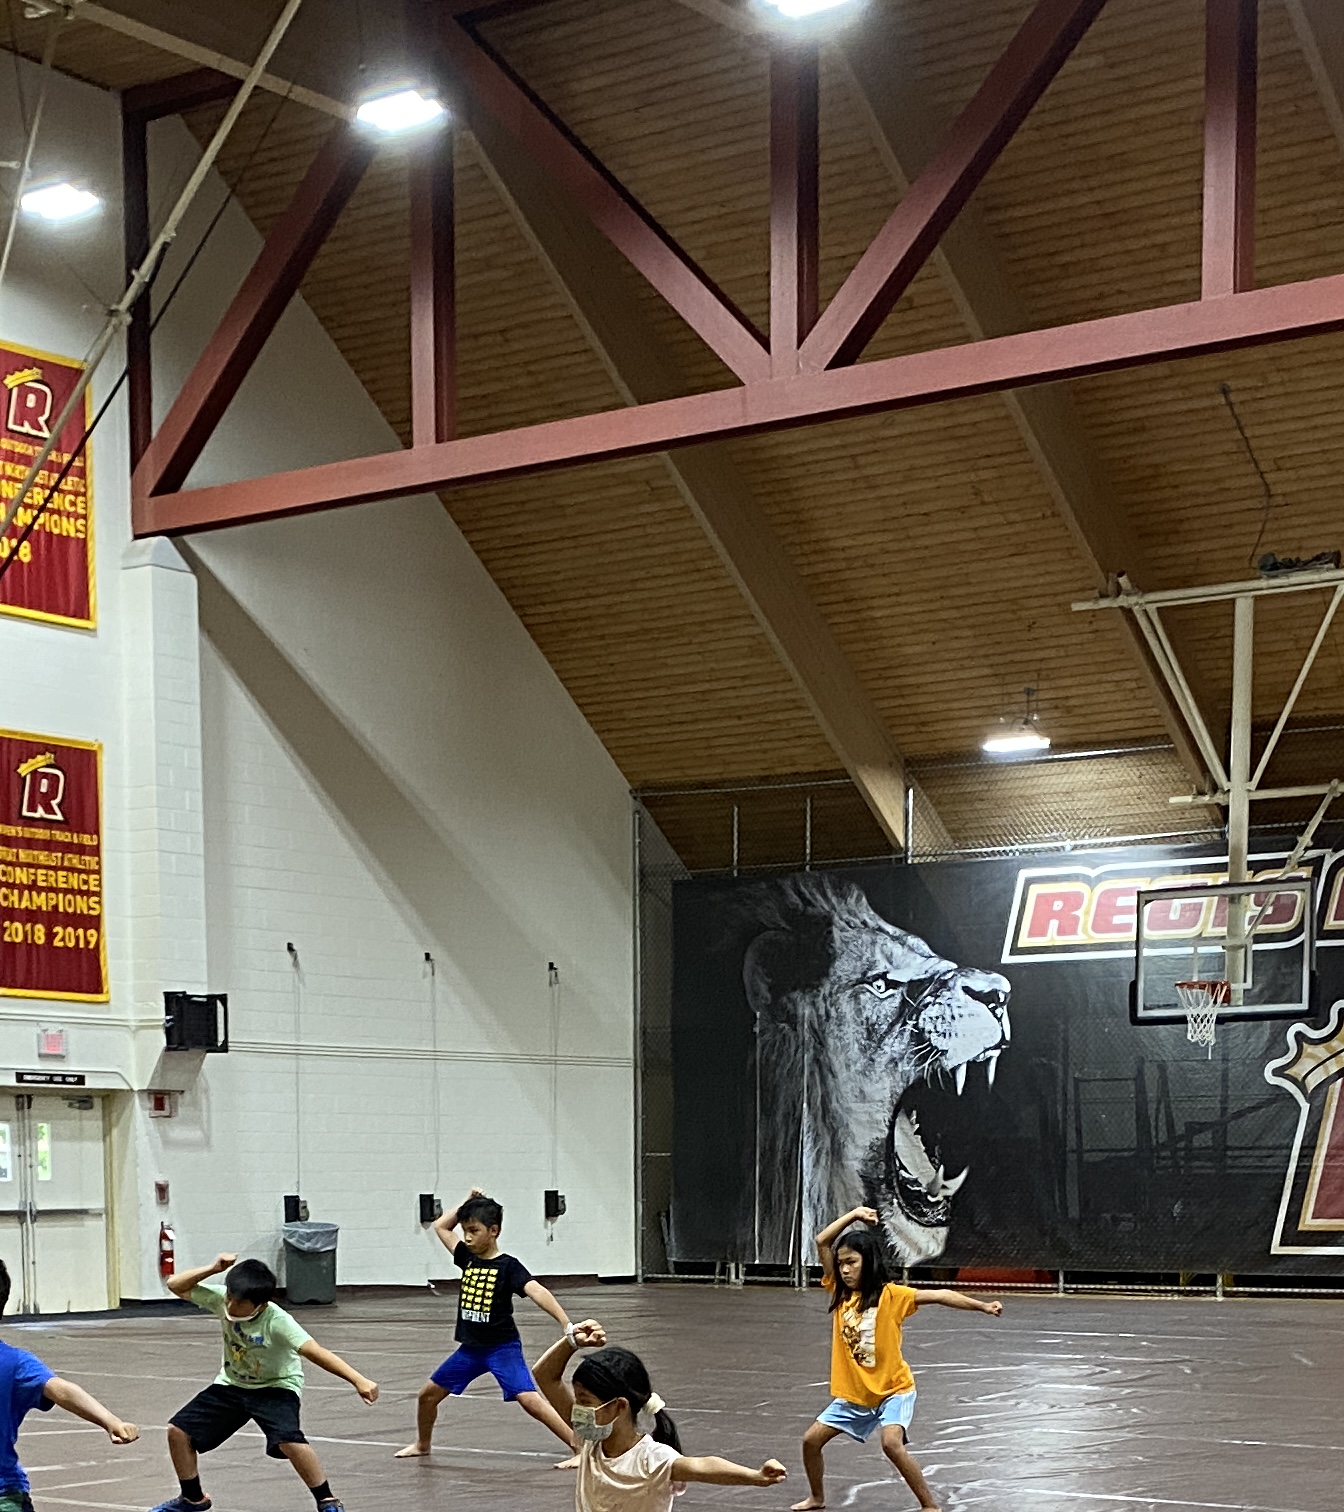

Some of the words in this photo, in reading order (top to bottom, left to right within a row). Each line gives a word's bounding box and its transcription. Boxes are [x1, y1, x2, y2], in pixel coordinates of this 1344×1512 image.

[8, 382, 53, 438] R
[21, 767, 64, 821] R
[0, 887, 102, 915] CHAMPIONS
[3, 921, 46, 945] 2018
[52, 926, 98, 949] 2019
